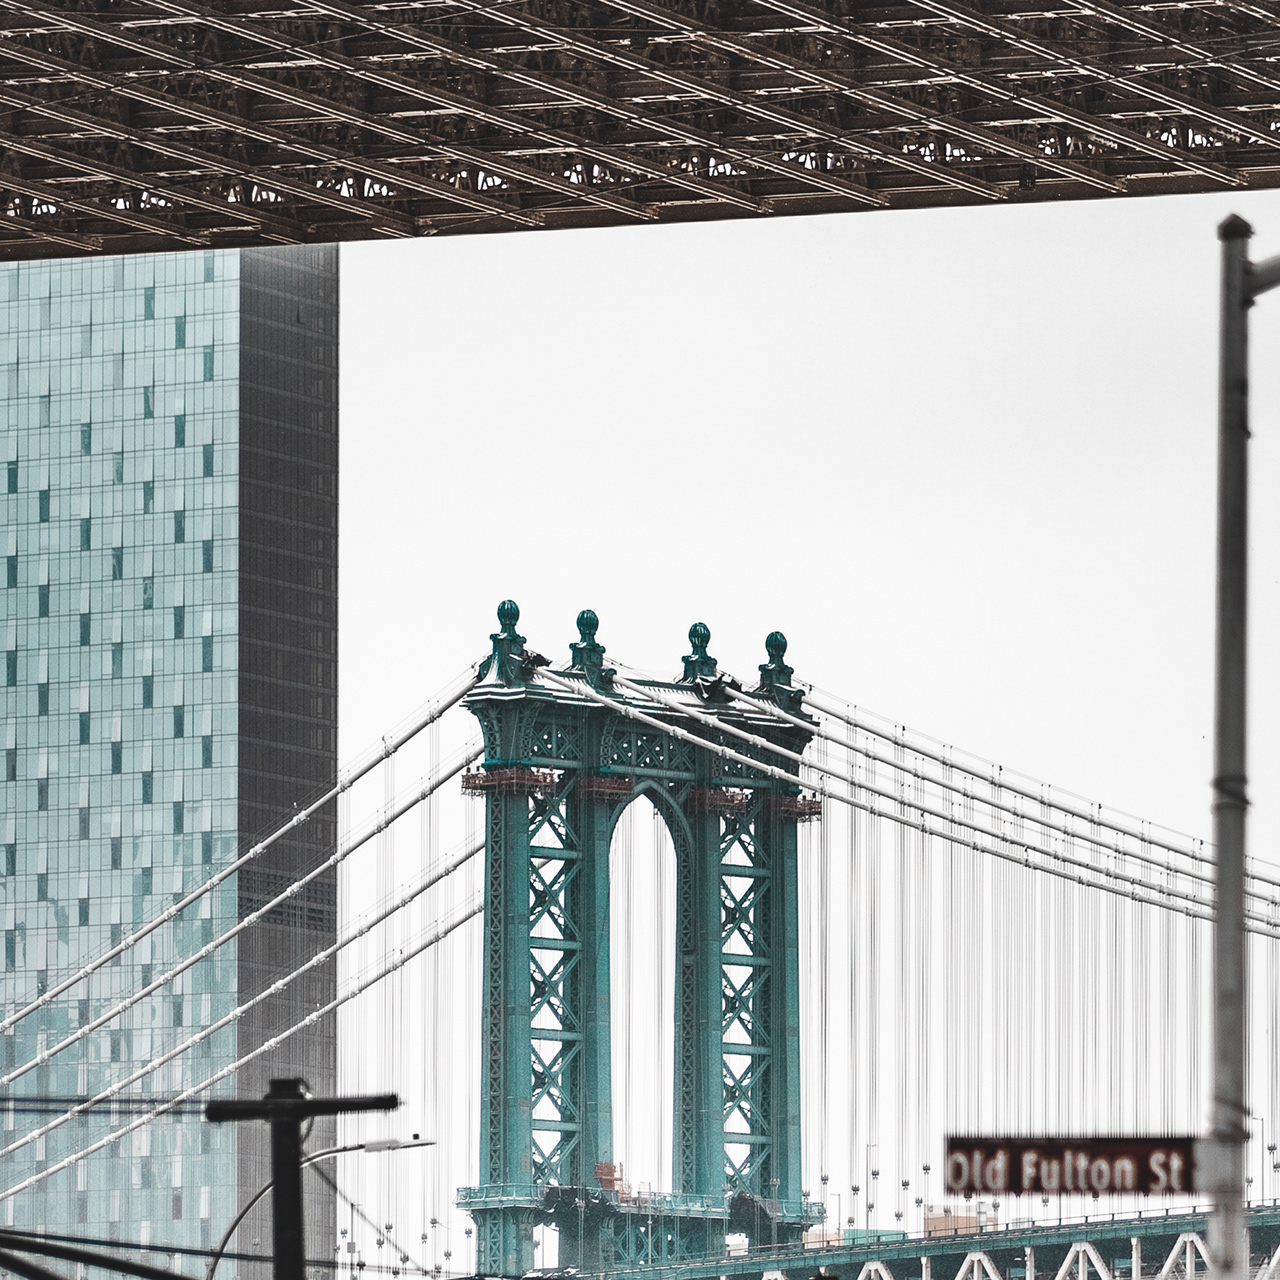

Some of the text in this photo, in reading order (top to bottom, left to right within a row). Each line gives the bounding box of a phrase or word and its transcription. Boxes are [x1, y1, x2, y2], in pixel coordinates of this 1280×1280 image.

[949, 1149, 1184, 1191] Old Fulton St
